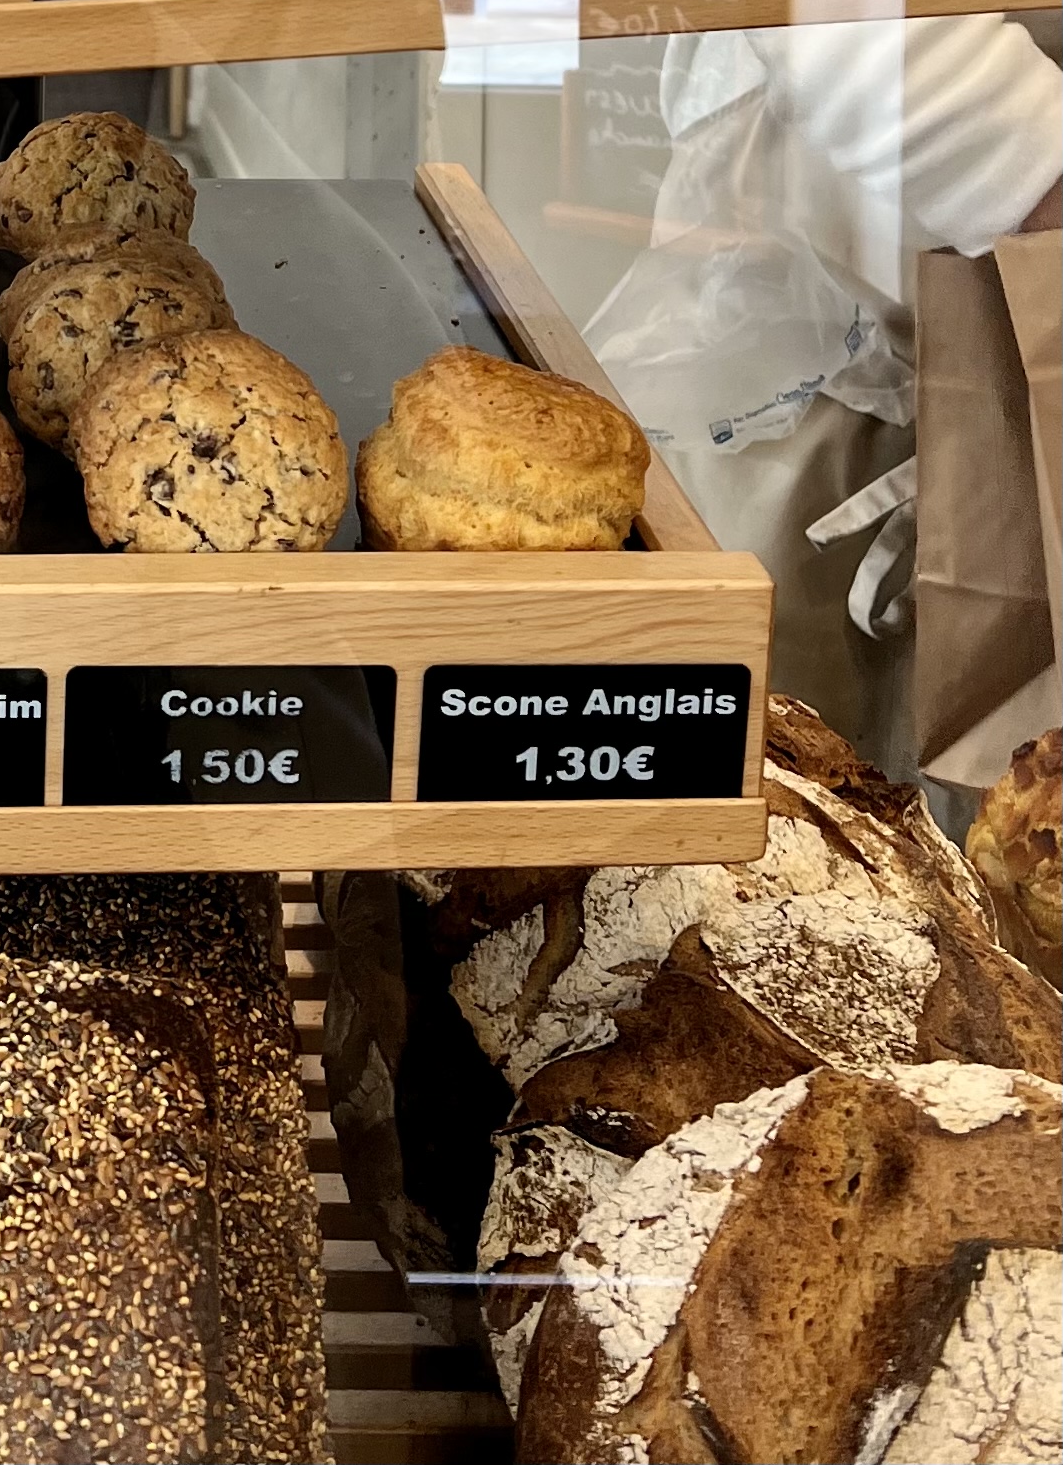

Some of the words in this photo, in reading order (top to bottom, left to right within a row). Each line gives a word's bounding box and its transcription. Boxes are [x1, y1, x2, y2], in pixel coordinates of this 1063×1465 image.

[160, 689, 304, 717] Cookie
[440, 688, 569, 717] Scone
[581, 687, 737, 722] Anglais
[515, 745, 655, 785] 1,30€
